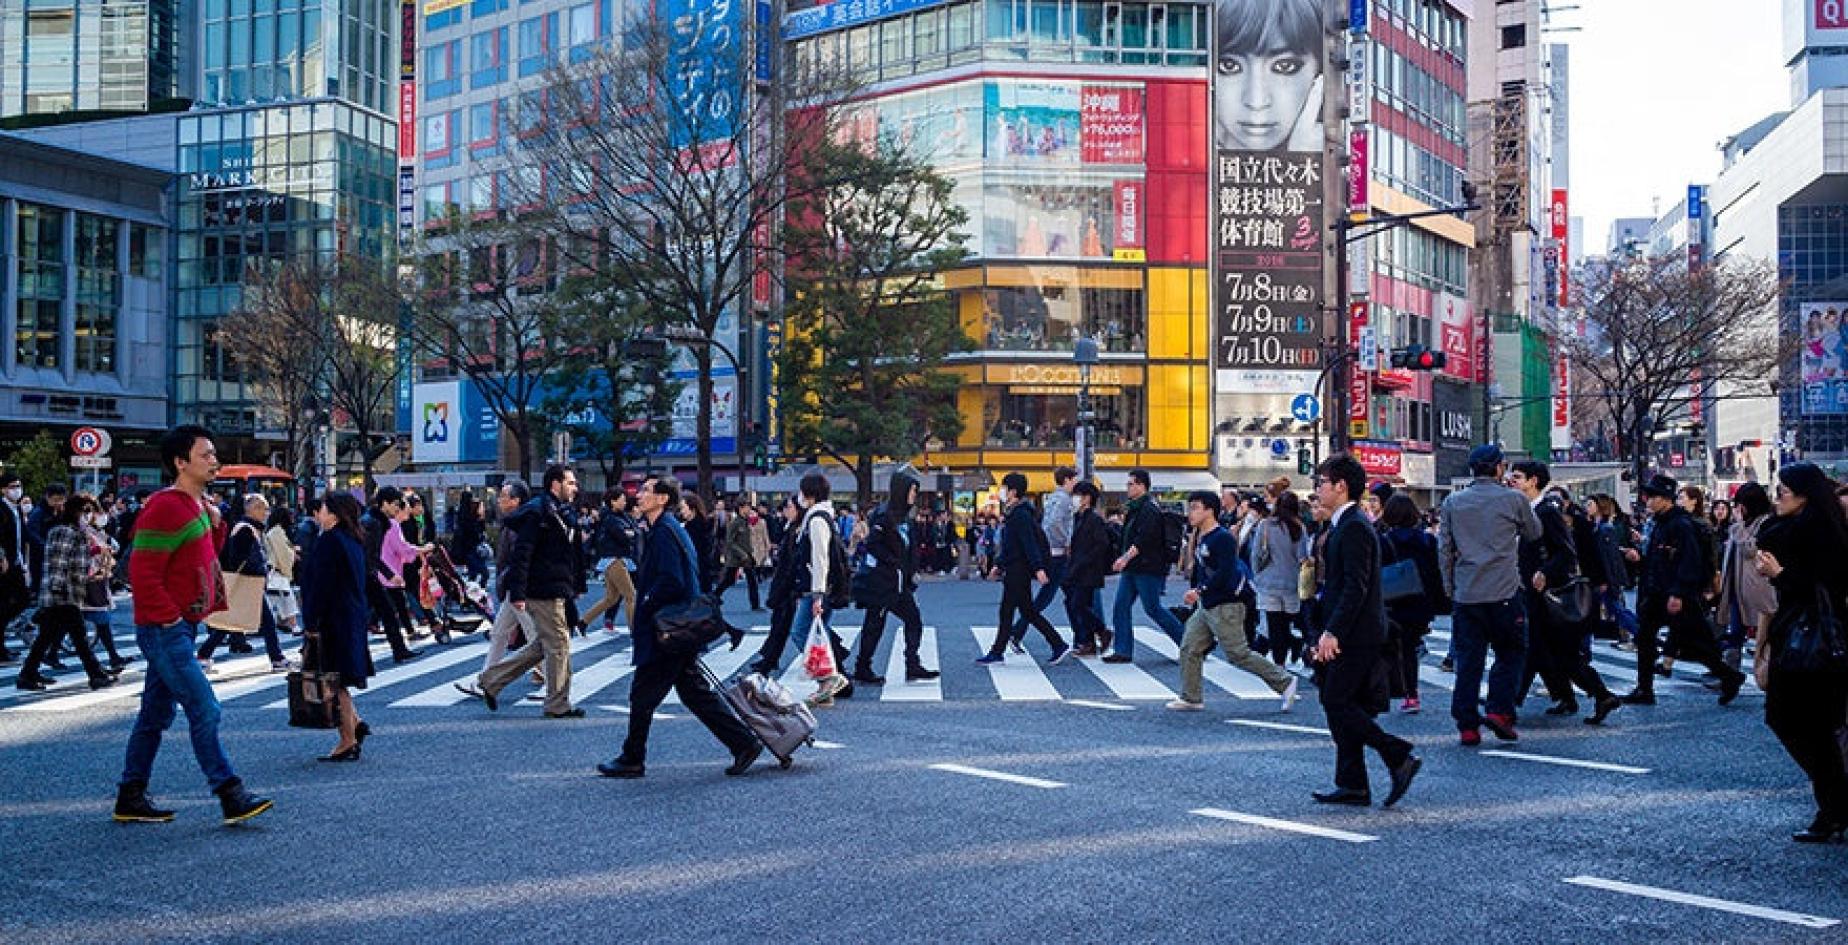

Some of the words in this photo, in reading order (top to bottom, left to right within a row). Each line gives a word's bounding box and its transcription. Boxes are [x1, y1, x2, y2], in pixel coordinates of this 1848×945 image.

[1220, 155, 1320, 186] 国立代々木
[1220, 187, 1321, 216] 競技場第一
[1221, 218, 1285, 247] 体育館
[1441, 410, 1471, 440] LUSH
